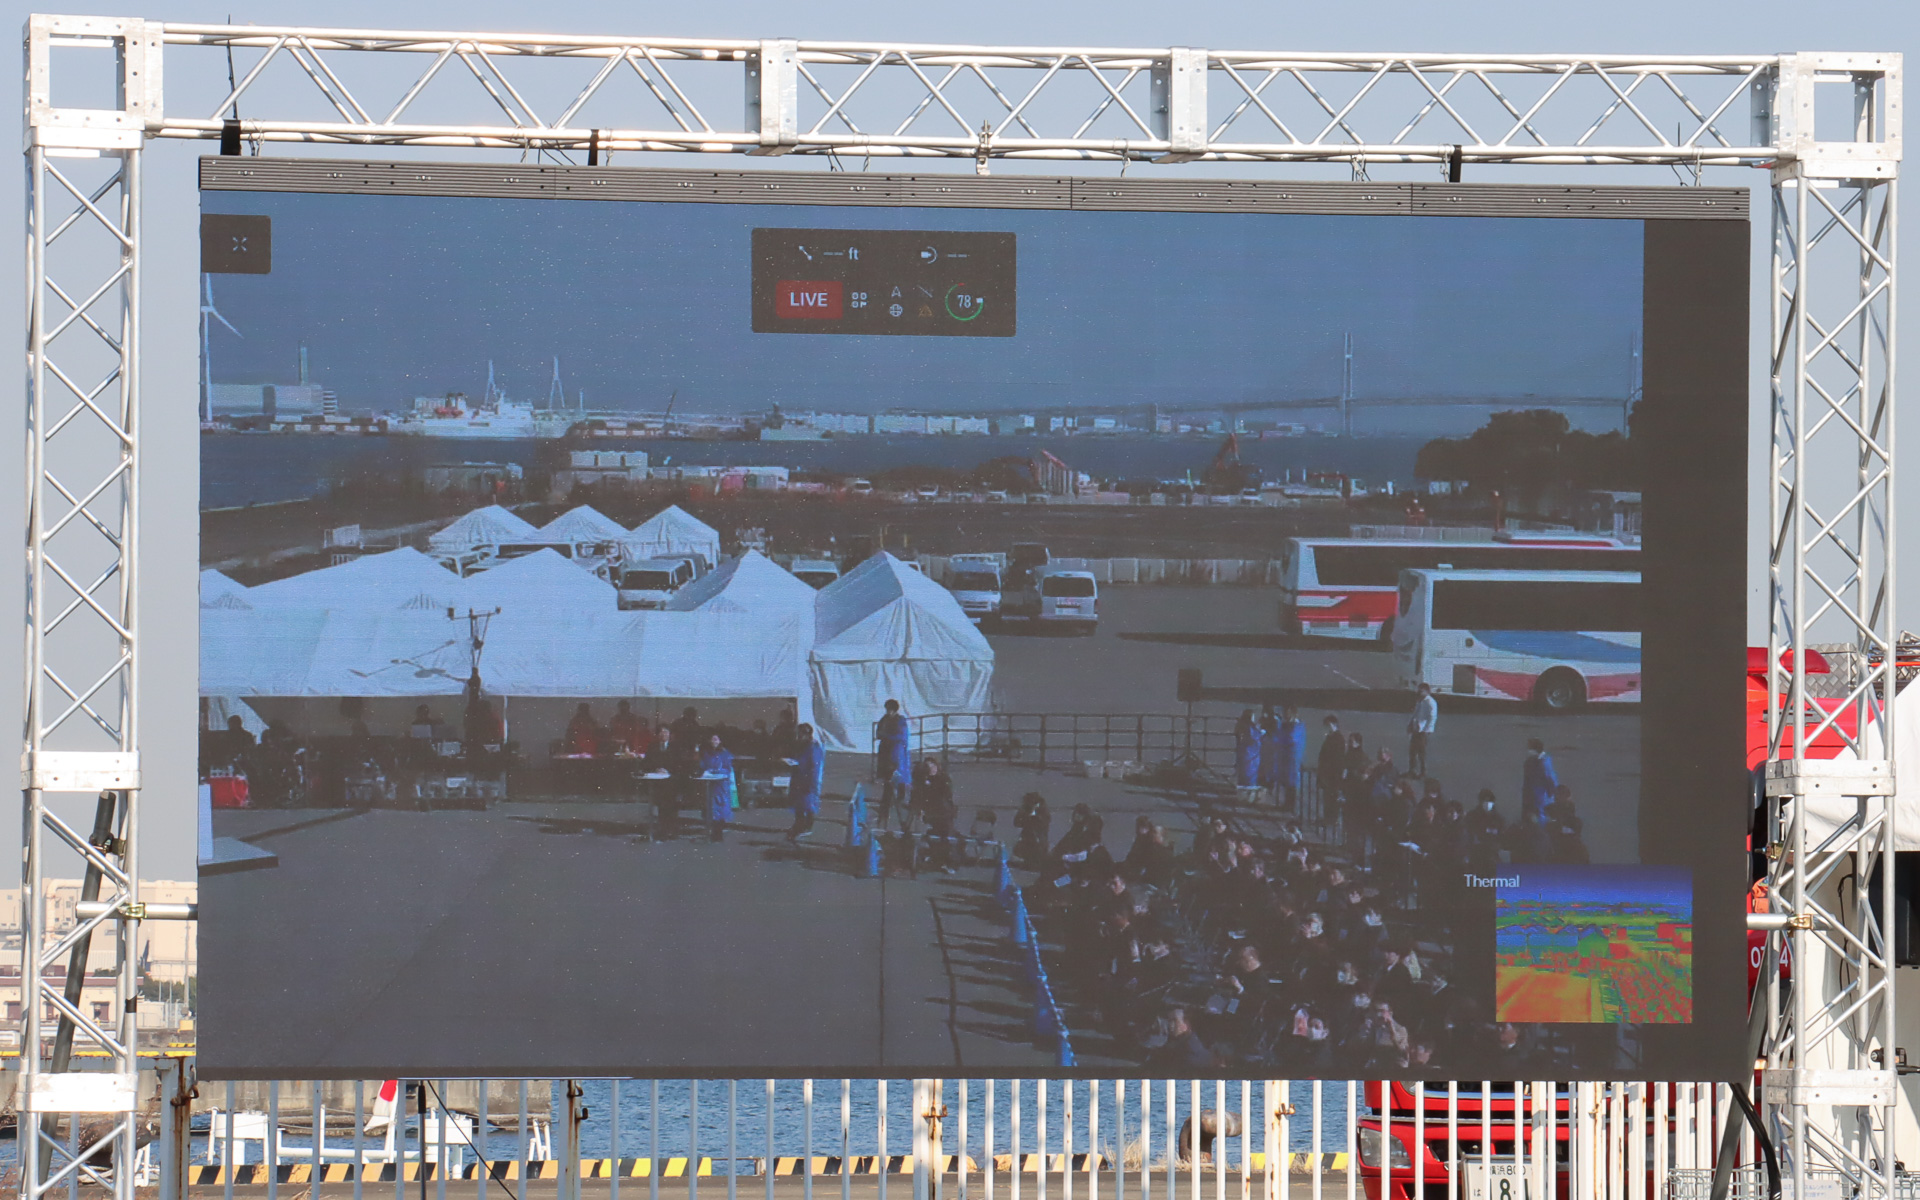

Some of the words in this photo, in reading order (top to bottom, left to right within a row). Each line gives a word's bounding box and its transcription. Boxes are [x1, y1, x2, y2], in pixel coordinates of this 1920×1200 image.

[848, 246, 860, 261] ft
[790, 292, 829, 307] LIVE
[957, 294, 972, 309] 78
[1463, 873, 1521, 888] Thermal
